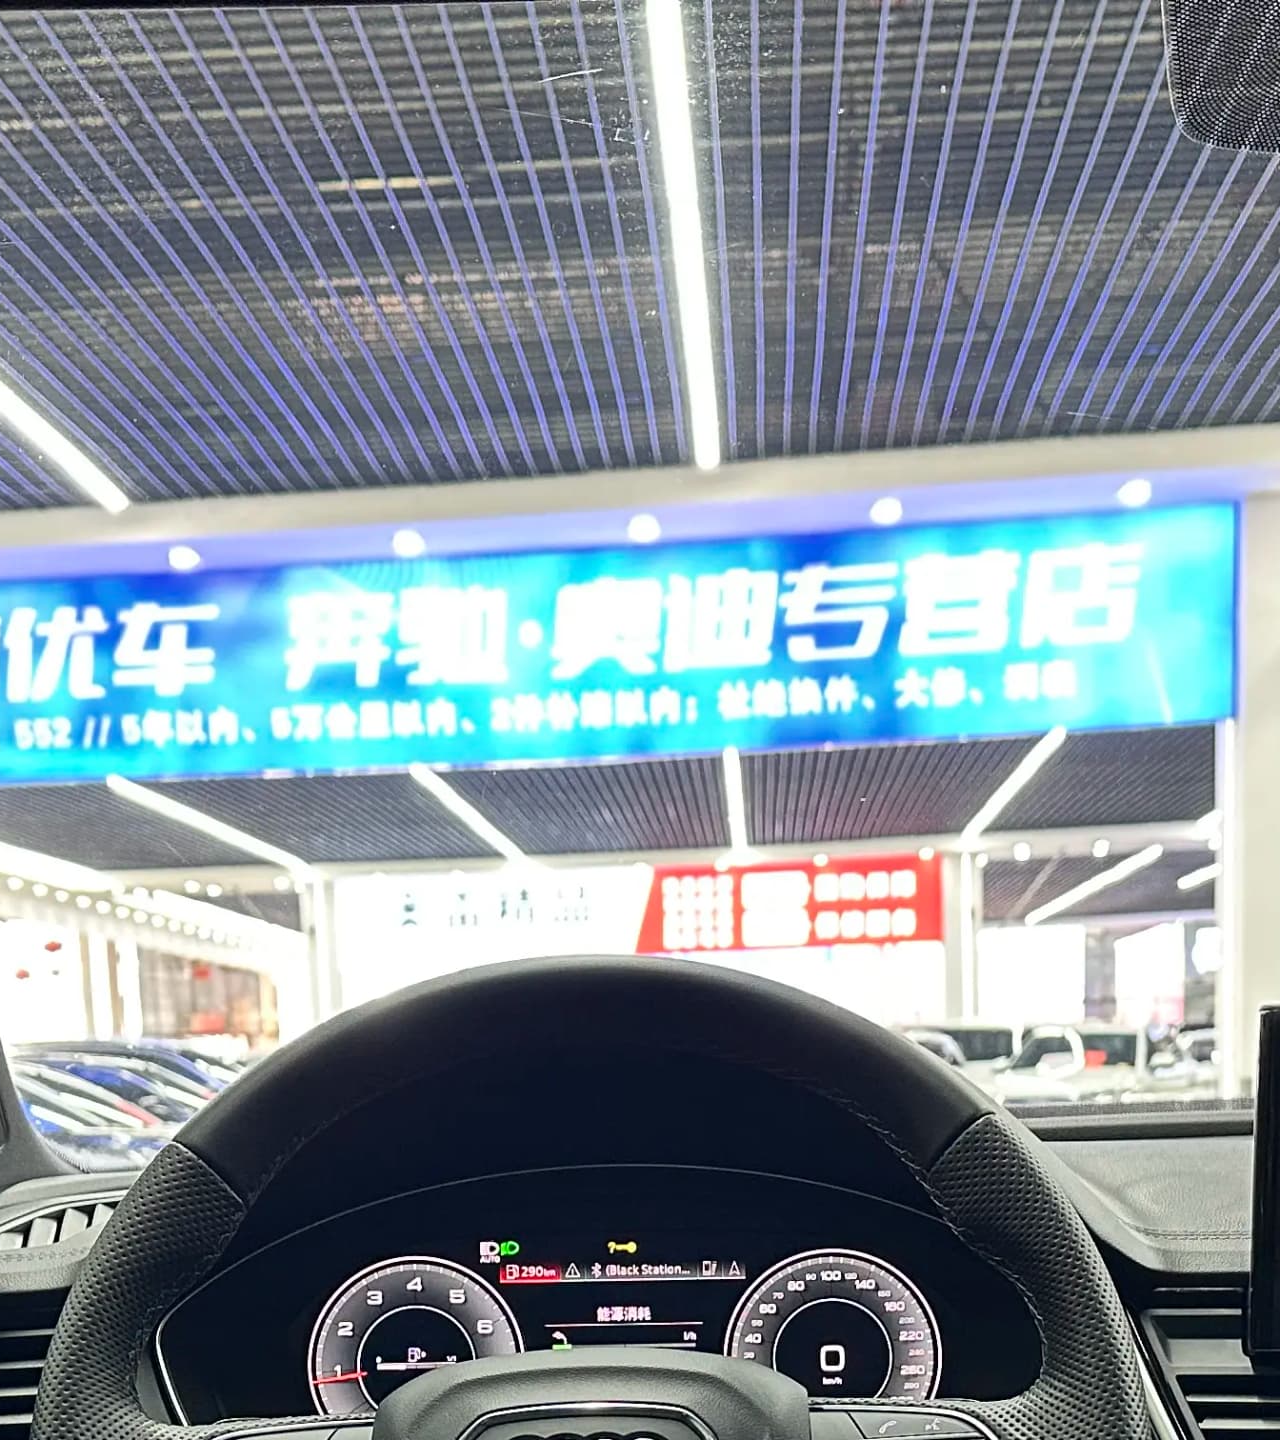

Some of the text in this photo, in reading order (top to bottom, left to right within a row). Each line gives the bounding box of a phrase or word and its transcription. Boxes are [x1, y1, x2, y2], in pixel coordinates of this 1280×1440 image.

[480, 1255, 500, 1264] AUTO
[605, 1263, 638, 1277] (Black
[820, 1270, 841, 1281] 100
[407, 1277, 423, 1292] 4
[854, 1279, 875, 1290] 140
[367, 1291, 383, 1305] 3
[449, 1289, 466, 1304] 5
[597, 1306, 651, 1322] 能源消耗
[337, 1322, 354, 1336] 2
[477, 1320, 494, 1335] 6
[744, 1332, 762, 1344] 40
[899, 1330, 924, 1342] 220
[820, 1344, 846, 1372] 0
